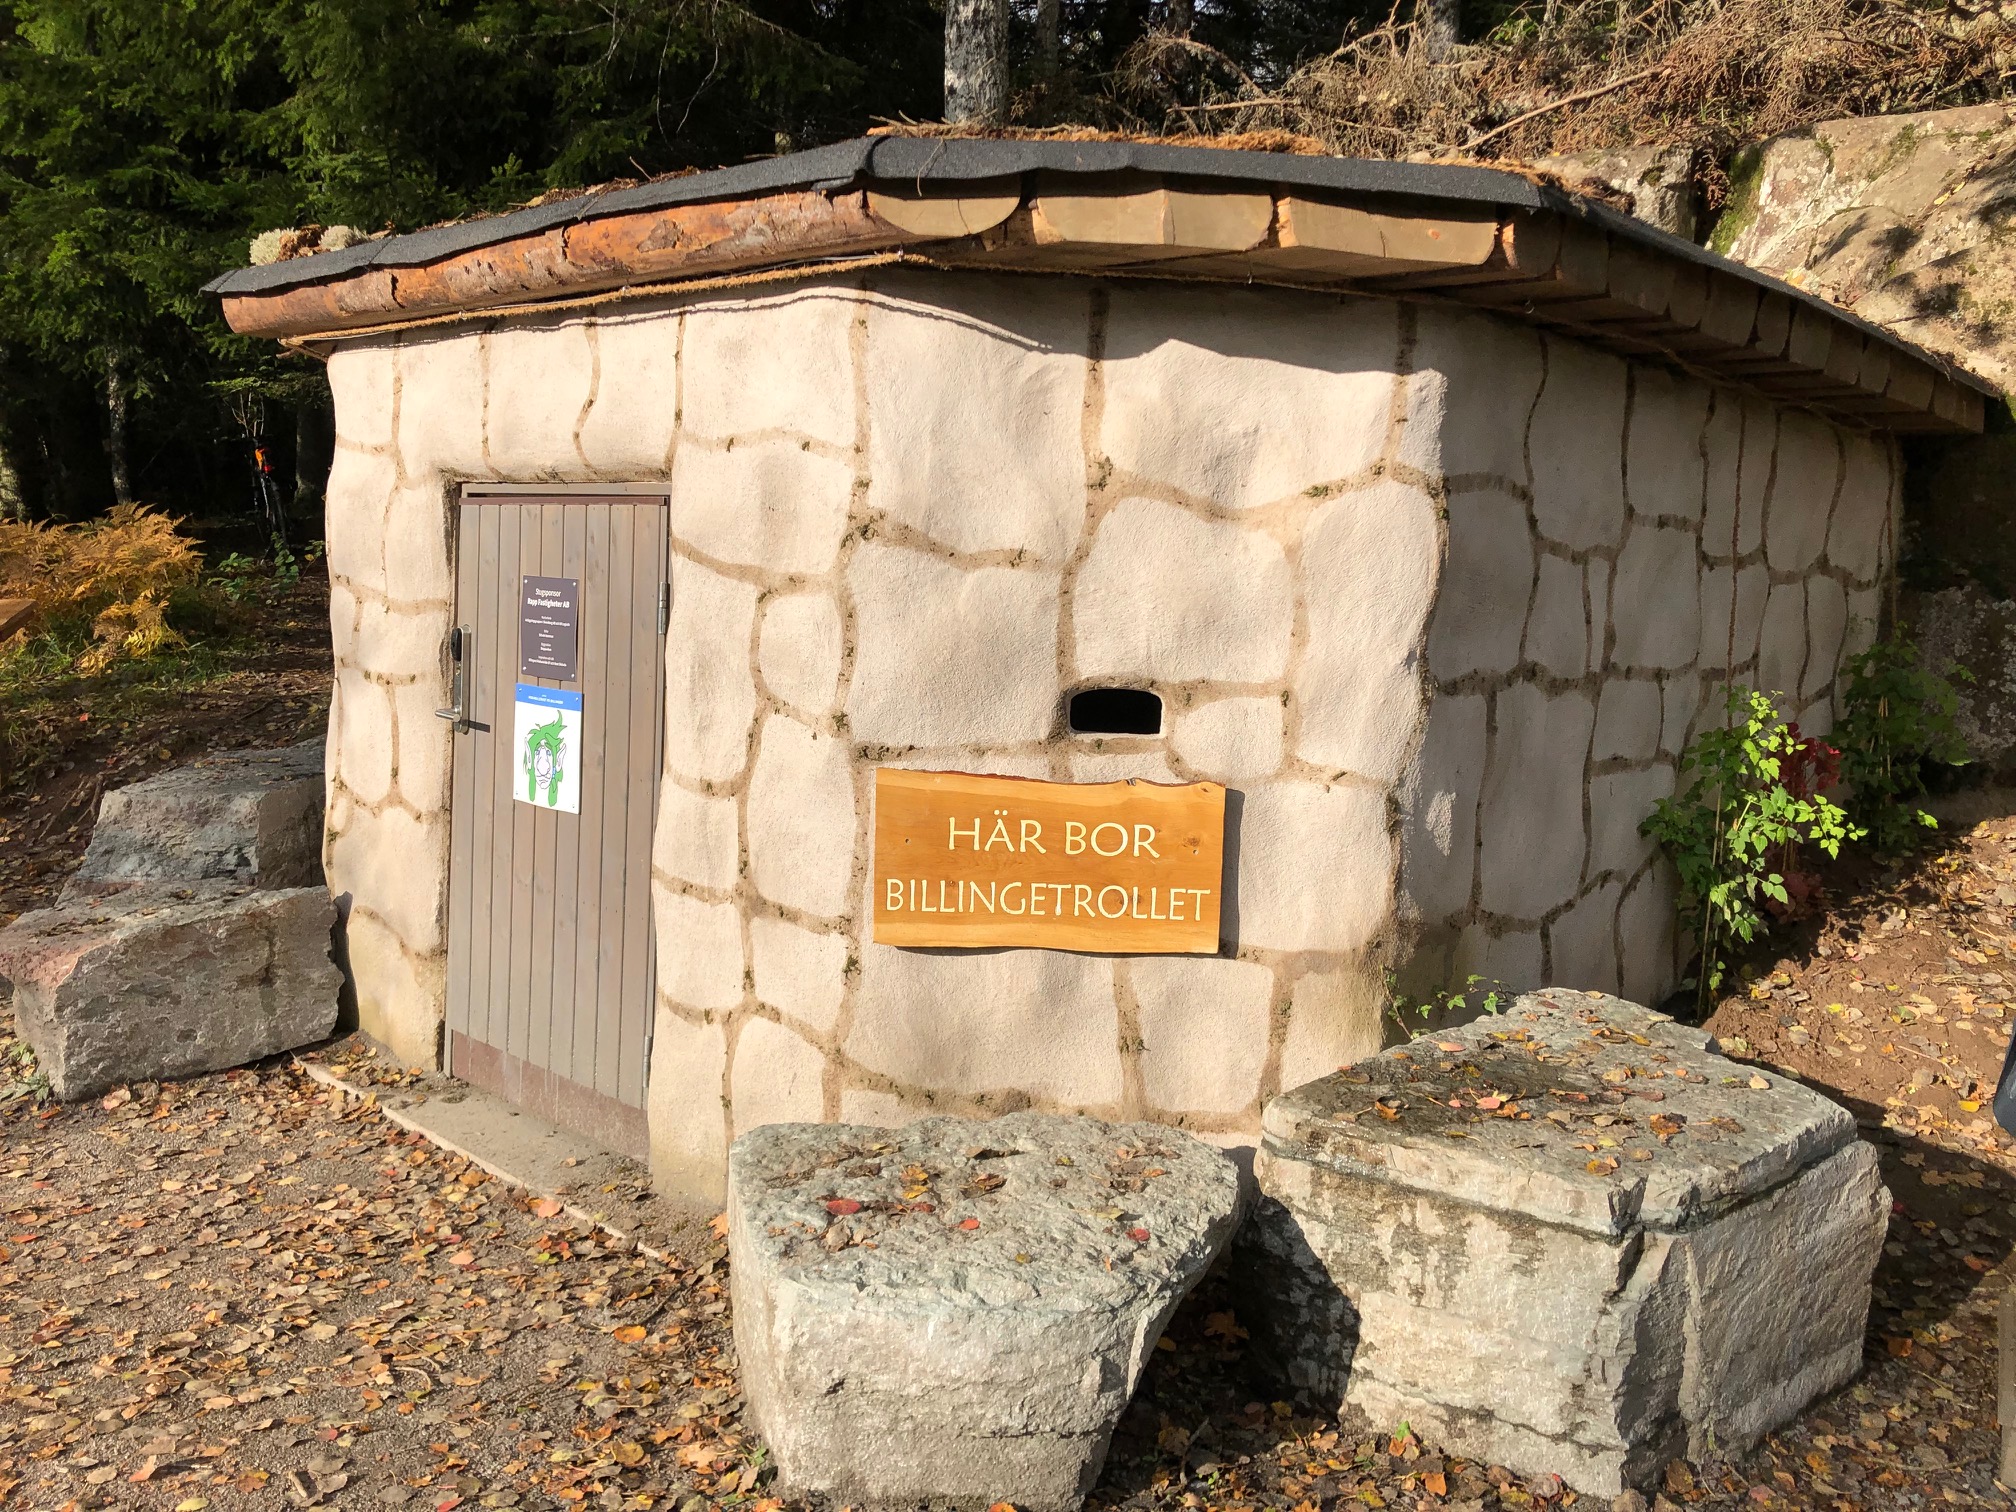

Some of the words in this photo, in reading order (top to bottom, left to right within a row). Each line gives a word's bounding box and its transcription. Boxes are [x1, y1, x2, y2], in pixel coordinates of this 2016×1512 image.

[538, 598, 562, 608] Fastigheter
[562, 601, 570, 609] AB
[949, 809, 1047, 854] HÄR
[1065, 821, 1160, 859] BOR
[886, 878, 1211, 922] BILLINGETROLLET
